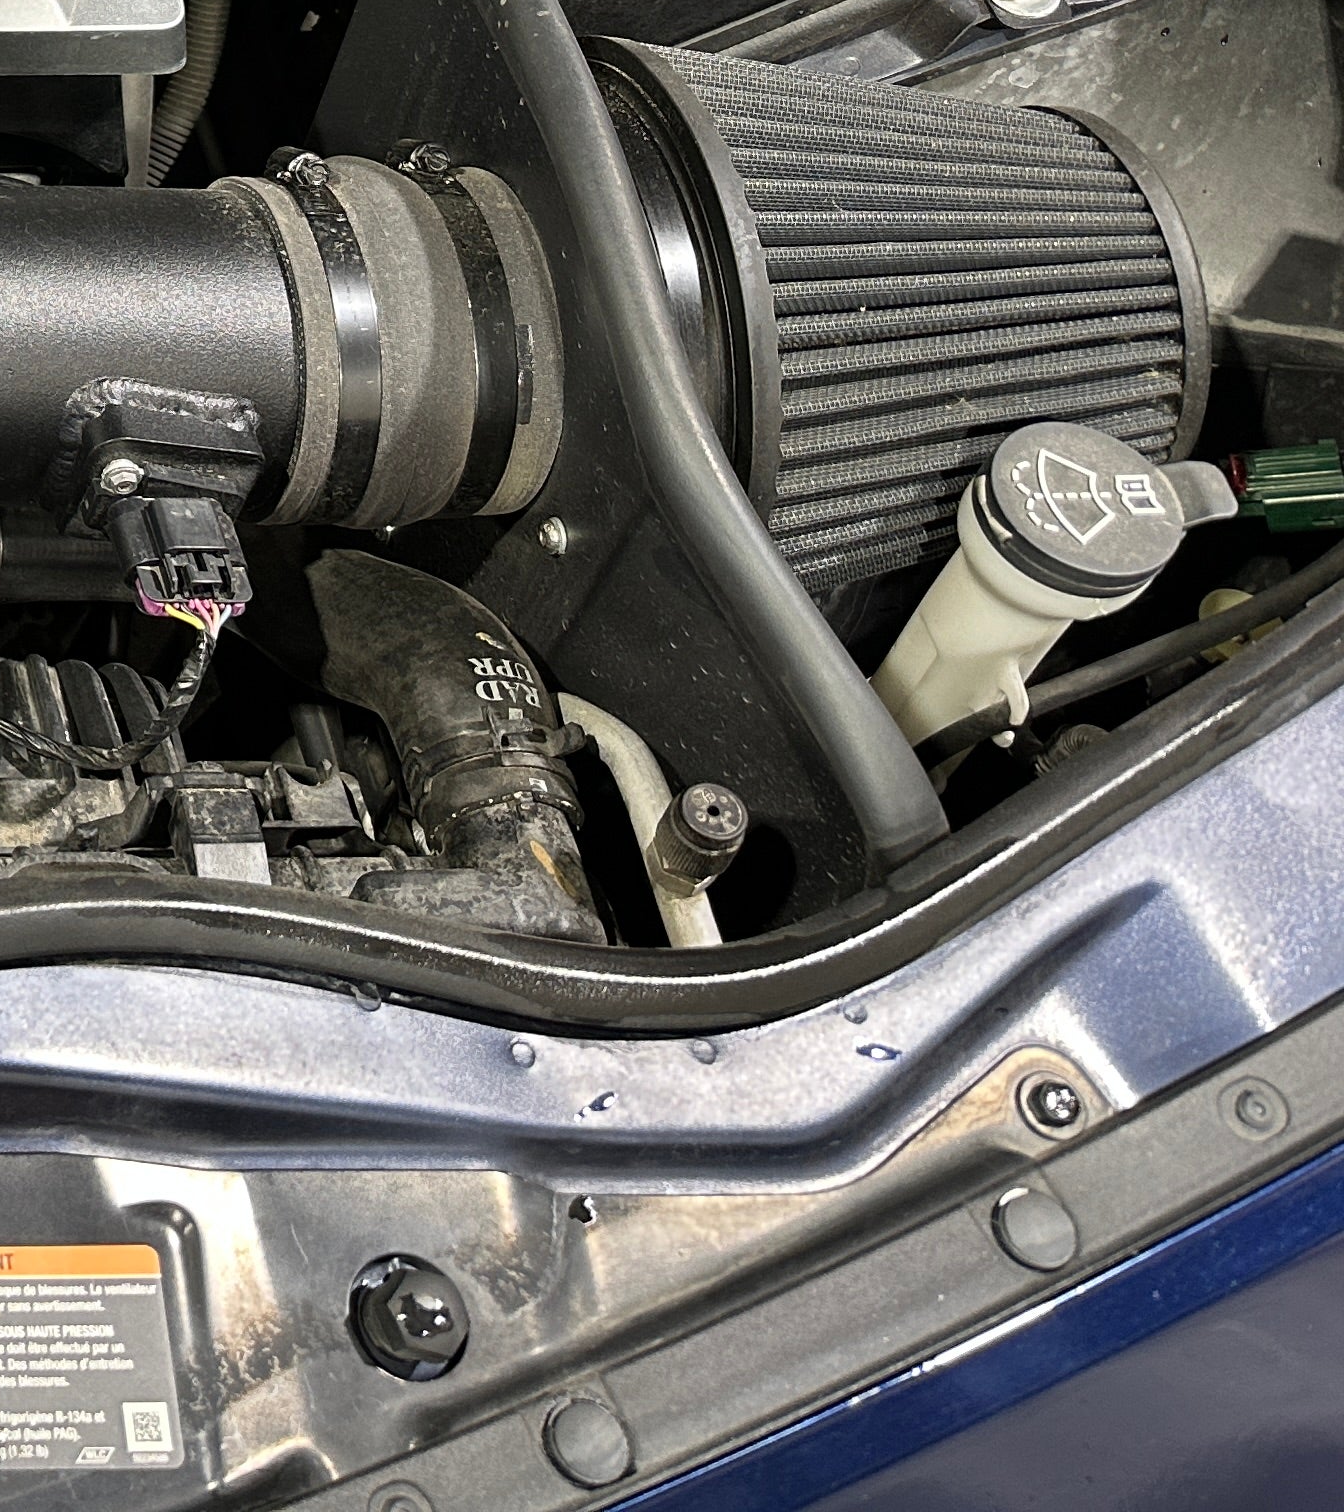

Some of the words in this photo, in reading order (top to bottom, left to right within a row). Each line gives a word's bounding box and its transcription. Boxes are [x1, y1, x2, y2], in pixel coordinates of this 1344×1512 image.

[468, 658, 535, 684] UPR
[475, 680, 542, 708] RAD
[28, 1326, 60, 1338] HAUTE
[63, 1325, 114, 1337] PRESSION
